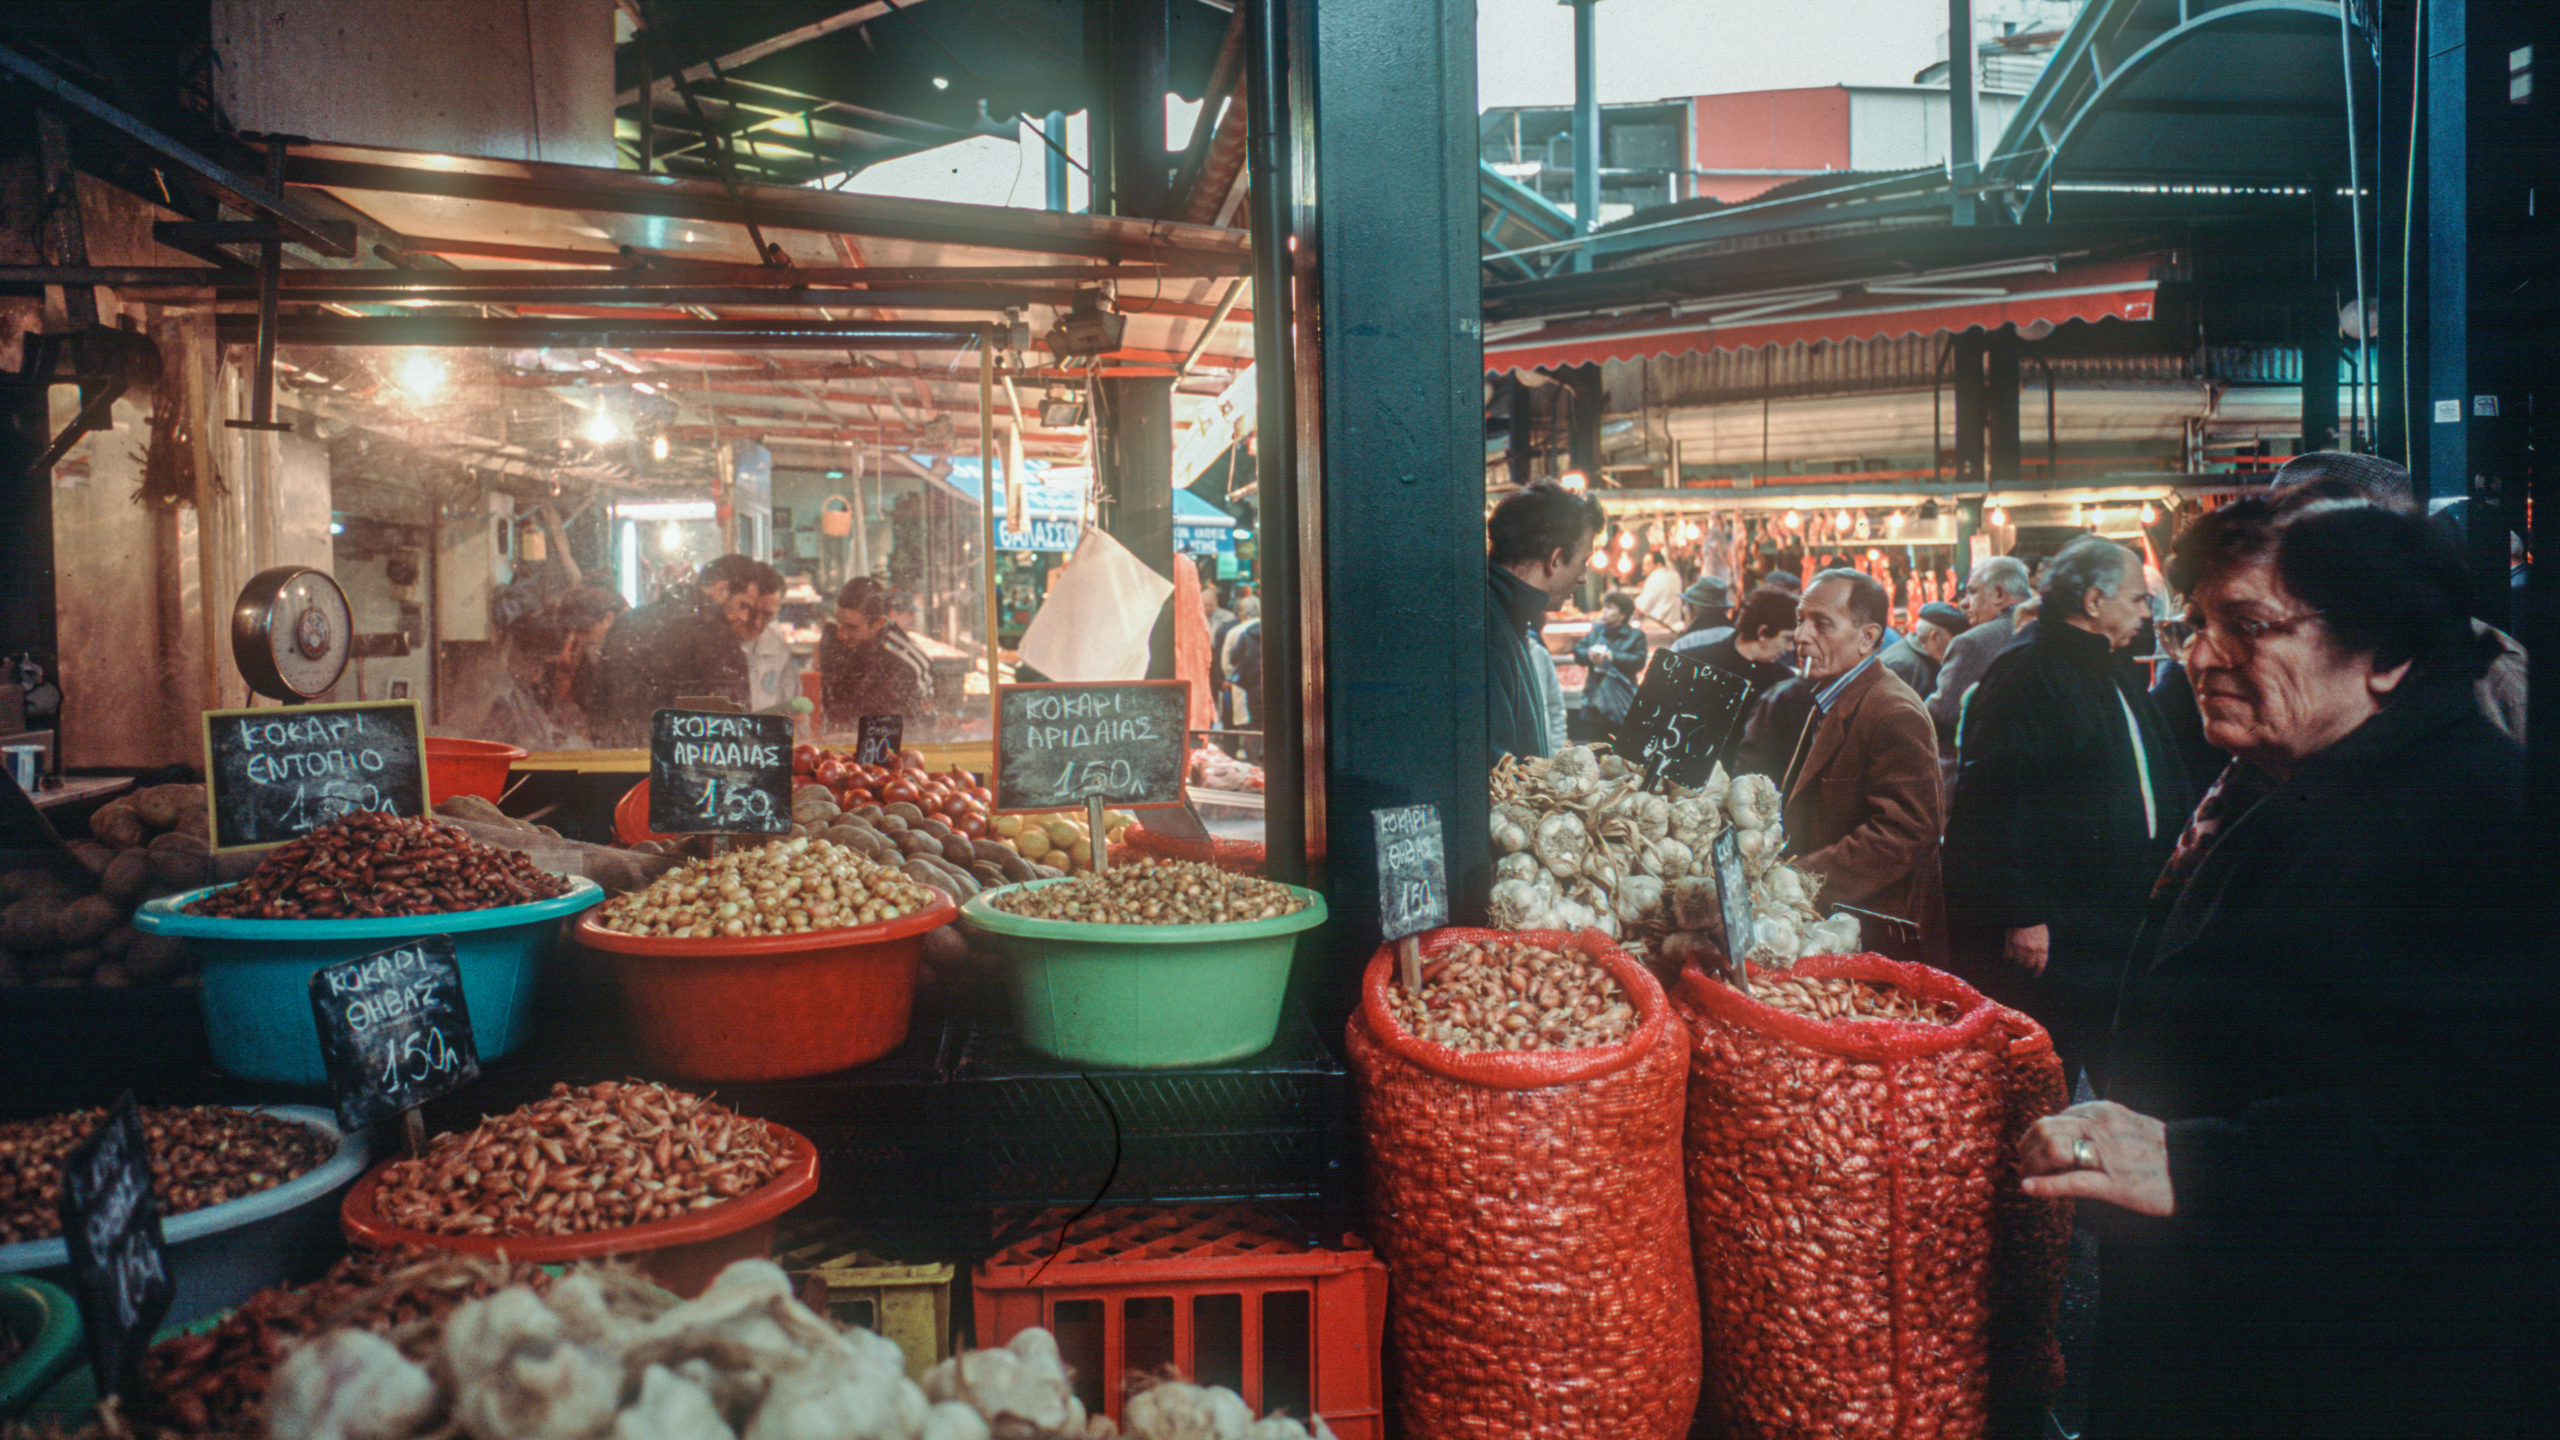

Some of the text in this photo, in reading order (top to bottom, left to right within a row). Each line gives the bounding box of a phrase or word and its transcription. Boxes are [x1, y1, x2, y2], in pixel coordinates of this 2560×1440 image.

[1025, 692, 1121, 720] ΚΟΚΑΡΙ
[240, 712, 364, 751] ΚΟΚΑΡΙ
[672, 715, 763, 738] ΚΟΚΑΡΙ
[1027, 715, 1160, 750] ΑΡΙΔΑΙΑΣ
[247, 748, 384, 785] ΕΝΤΟΠΙΟ
[673, 741, 780, 769] ΑΡΙΔΑΙΑΣ
[1380, 807, 1427, 835] ΚΟΚΑΡΙ
[323, 945, 428, 997] ΚΟΚΑΡΙ
[345, 975, 441, 1031] ΘΗΒΑΣ
